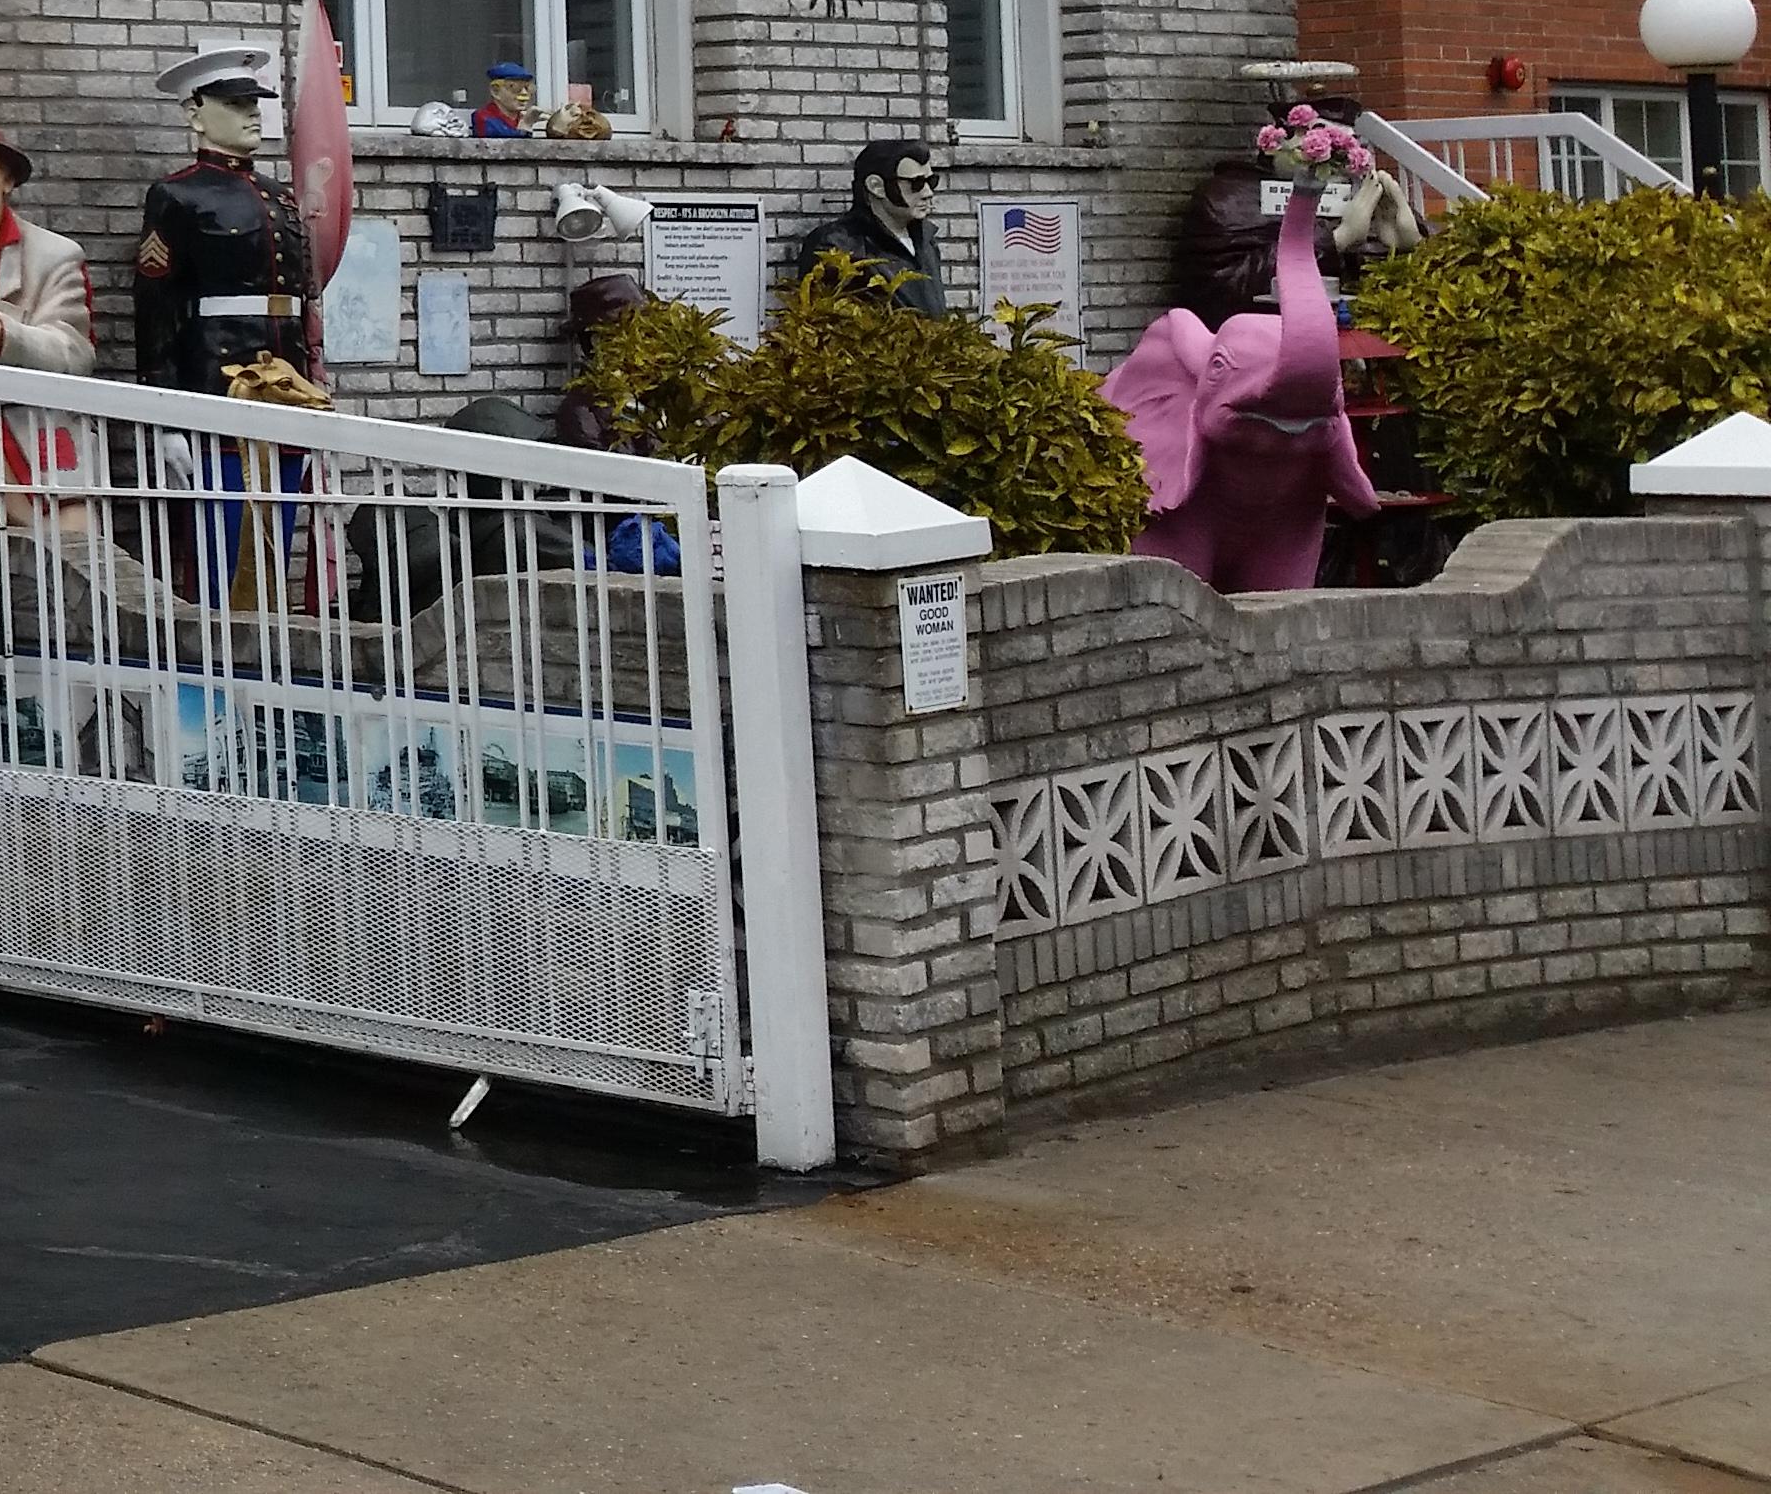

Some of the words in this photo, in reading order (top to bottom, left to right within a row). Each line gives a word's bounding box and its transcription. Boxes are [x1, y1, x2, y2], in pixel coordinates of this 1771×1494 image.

[654, 208, 678, 219] RESPECT
[693, 208, 698, 219] A
[698, 208, 728, 219] BROOKLYN
[907, 581, 958, 606] WANTED!
[919, 606, 949, 621] GOOD
[915, 620, 954, 635] WOMAN
